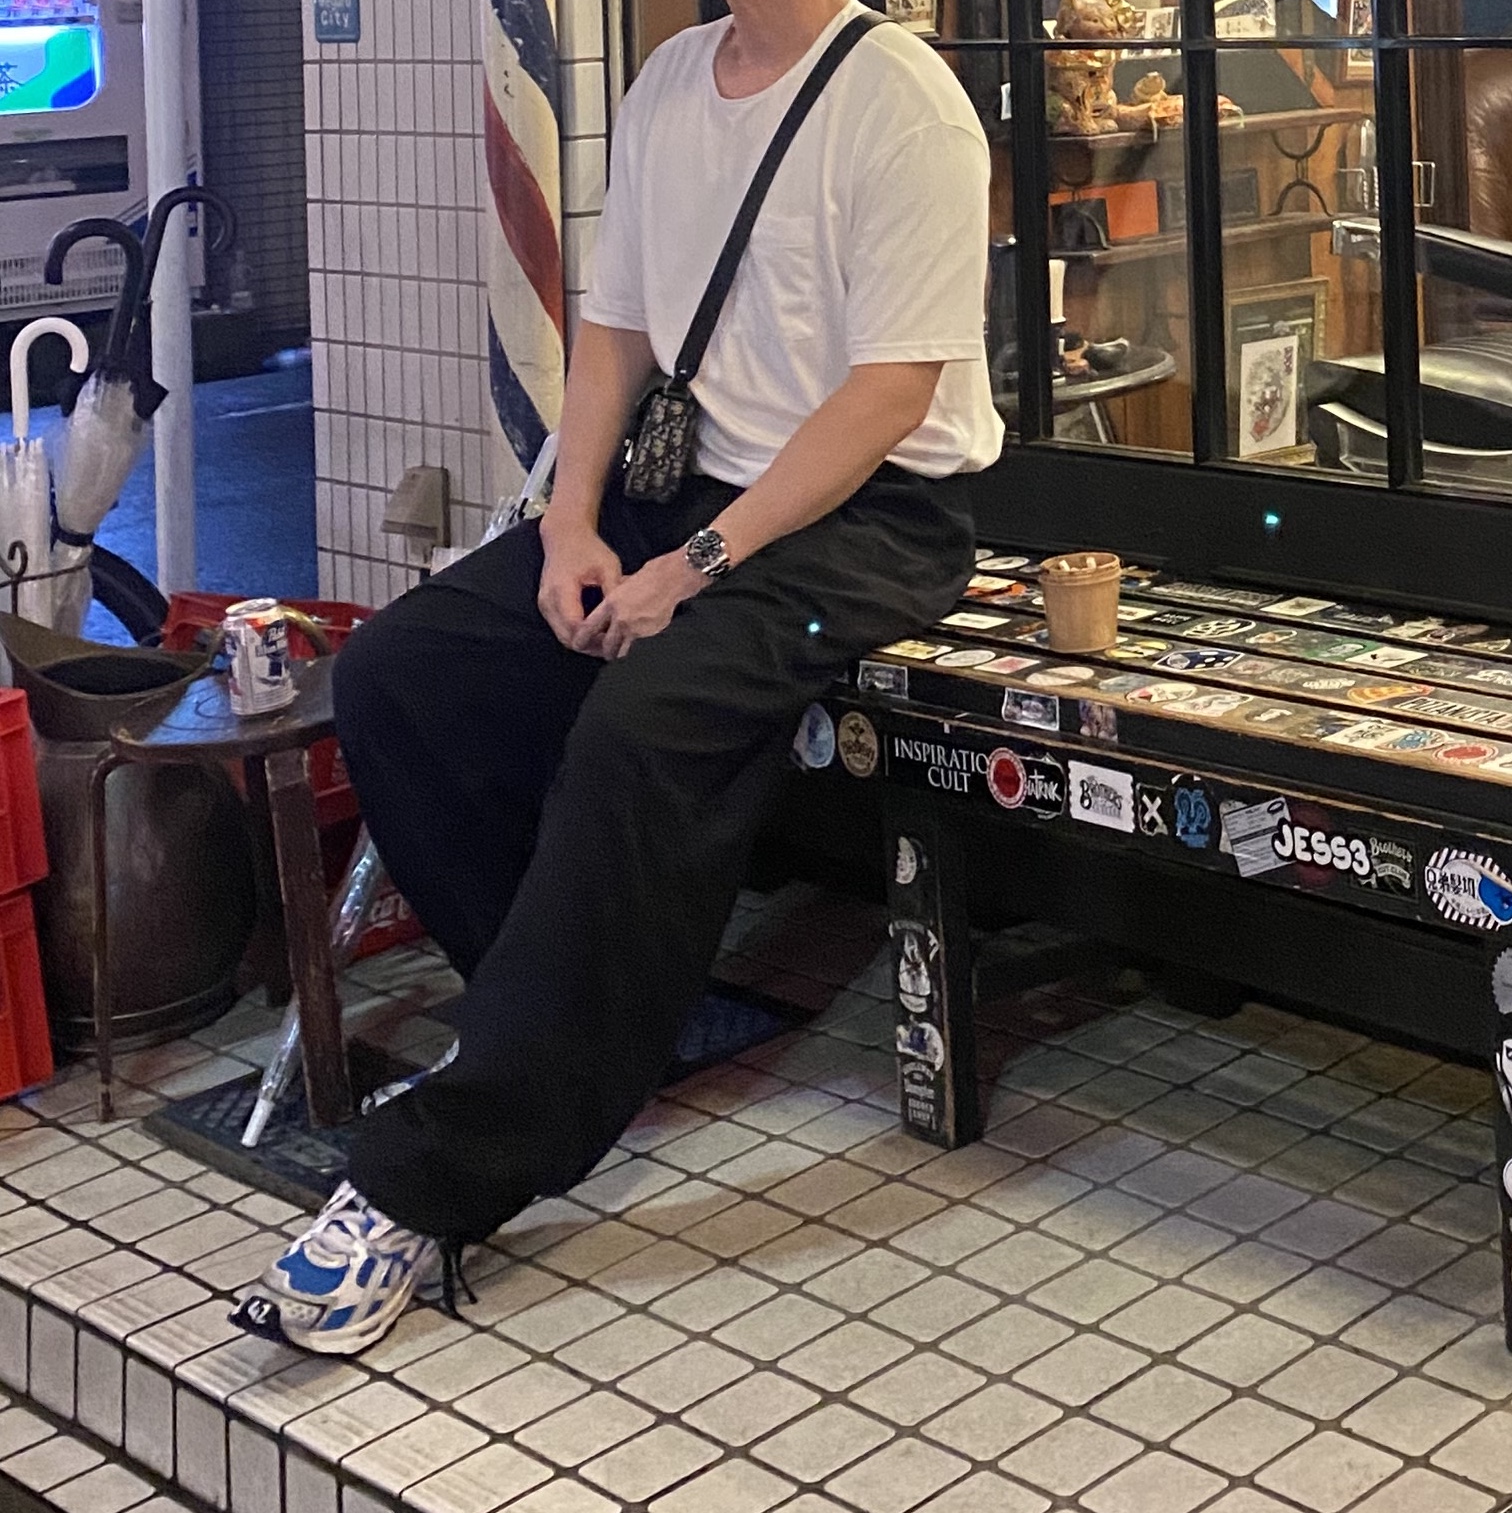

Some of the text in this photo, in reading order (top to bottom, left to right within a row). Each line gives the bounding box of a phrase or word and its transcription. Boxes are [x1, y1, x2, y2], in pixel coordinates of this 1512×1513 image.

[320, 11, 349, 28] City
[894, 737, 988, 775] INSPIRATIO
[927, 766, 971, 793] CULT
[1274, 824, 1370, 876] JESS3
